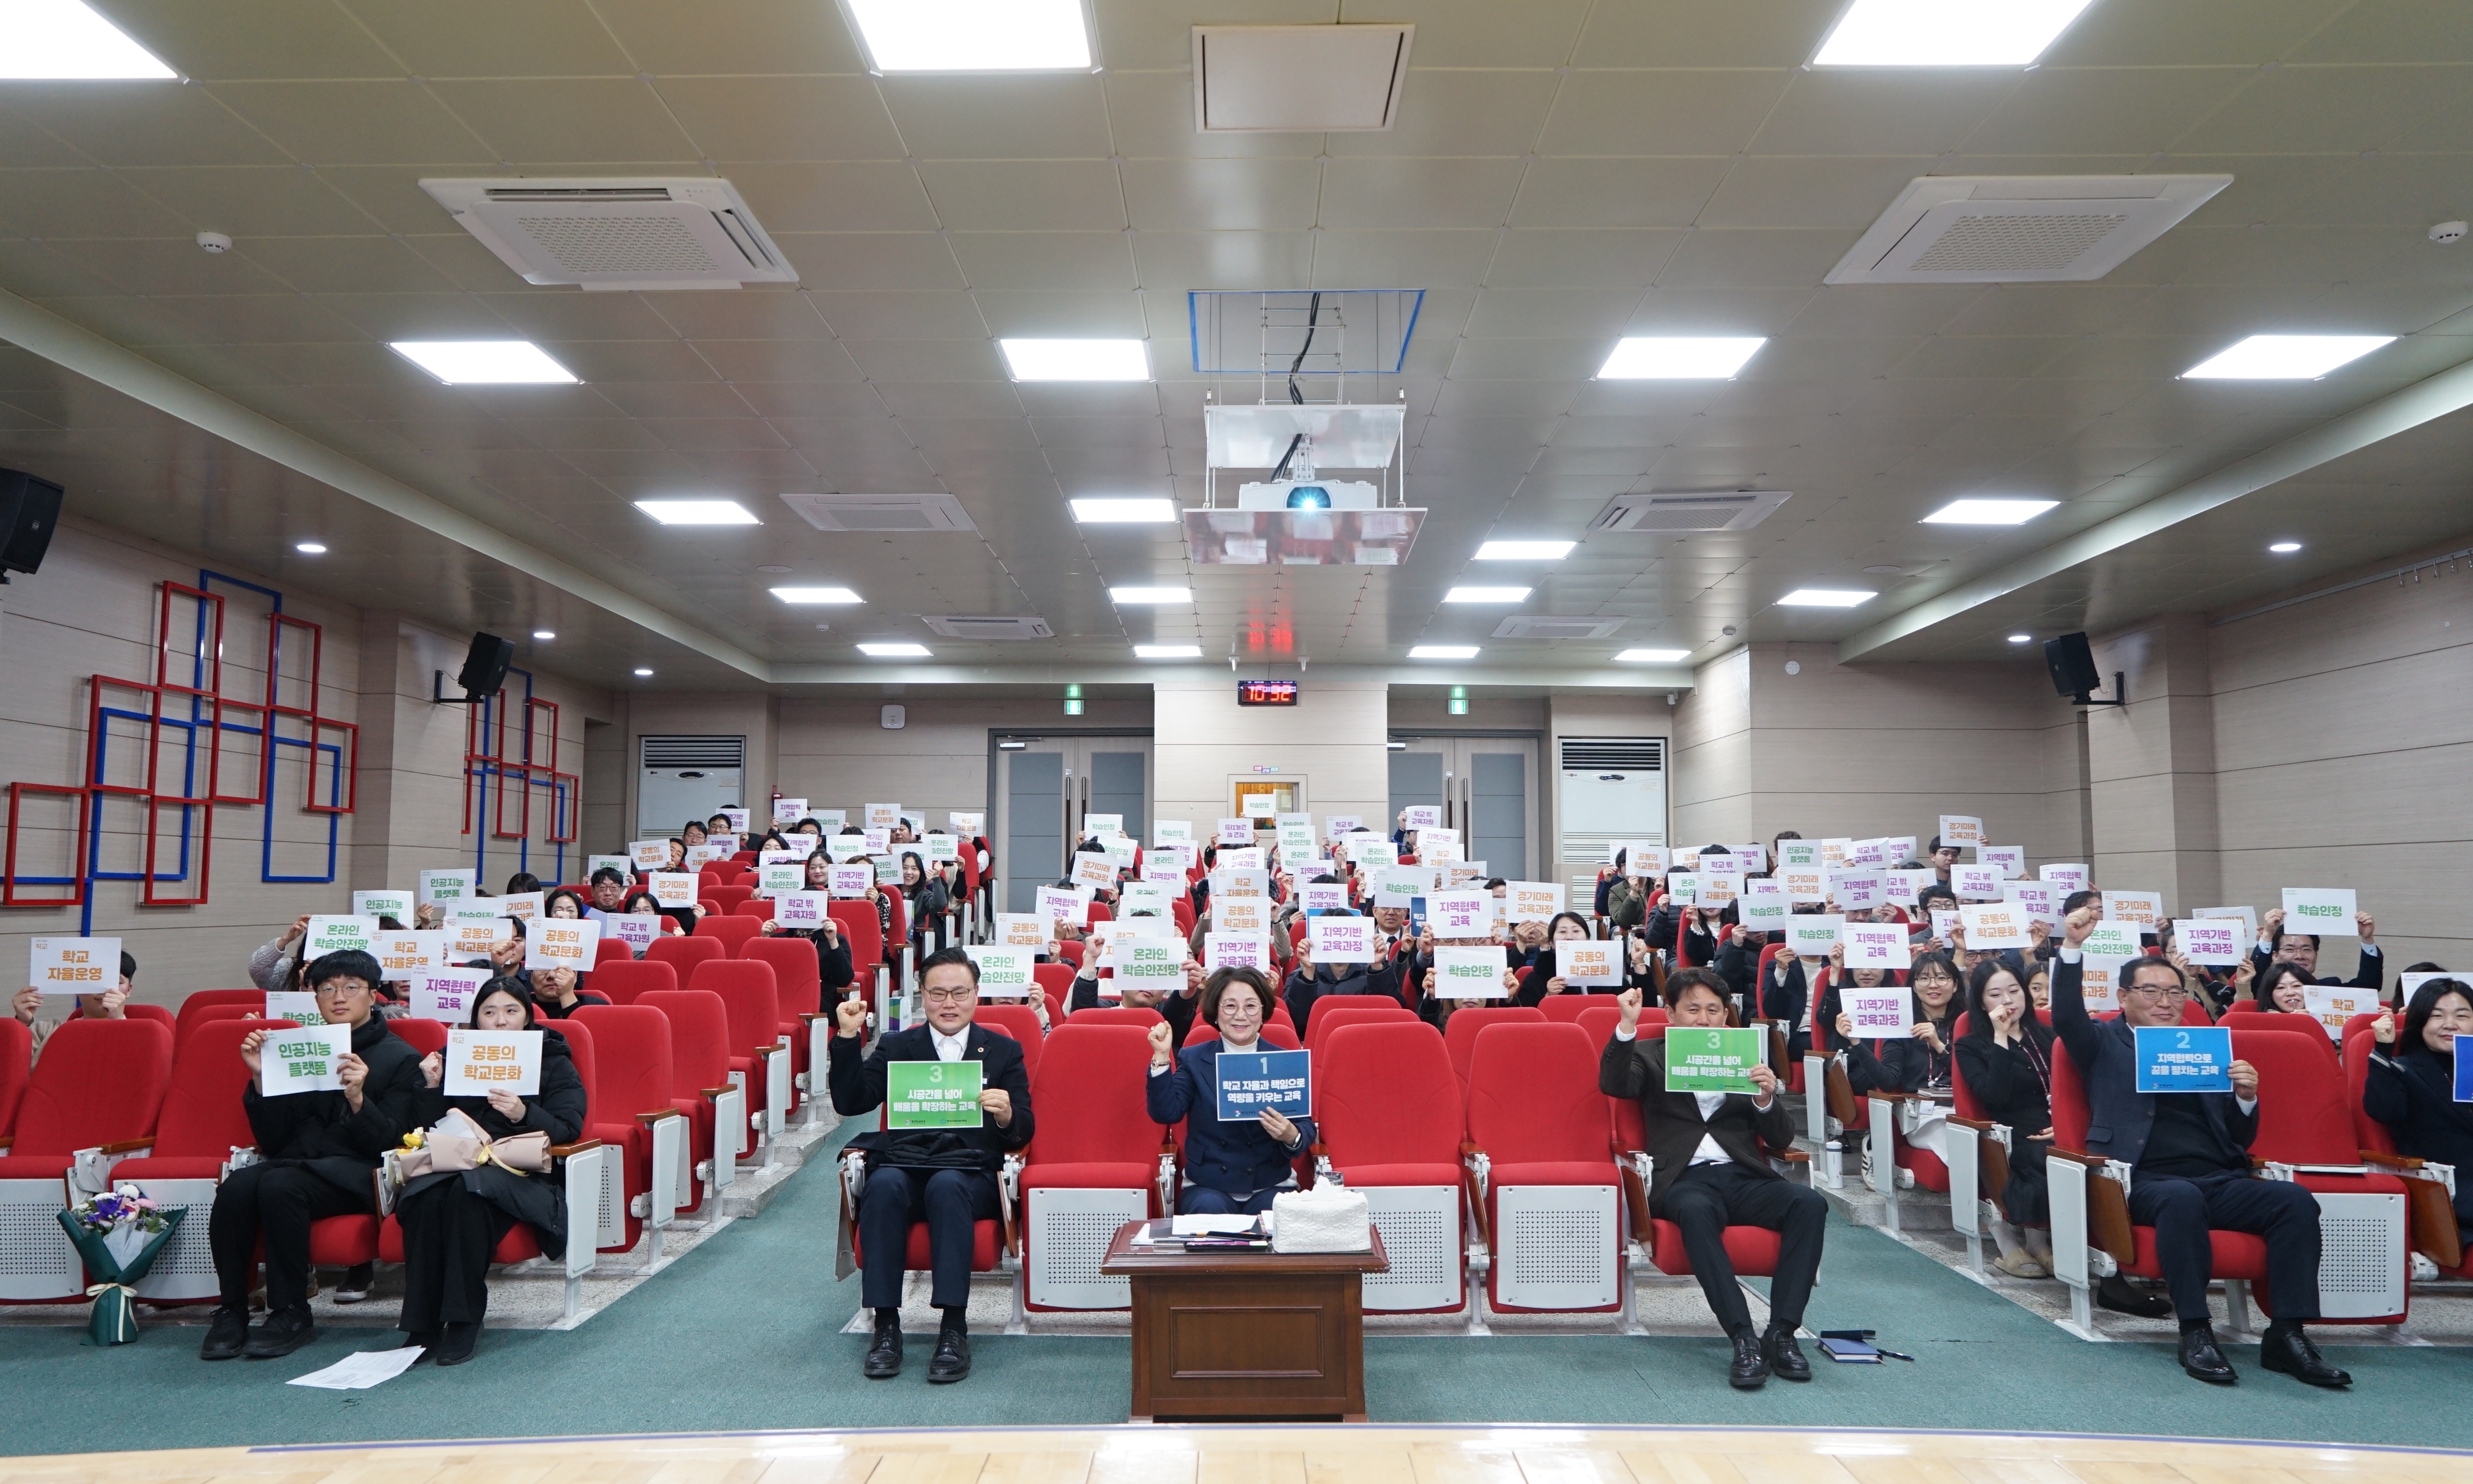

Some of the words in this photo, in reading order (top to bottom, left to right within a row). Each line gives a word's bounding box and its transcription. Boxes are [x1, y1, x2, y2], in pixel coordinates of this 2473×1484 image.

[1426, 833, 1451, 842] 지역기반
[1856, 846, 1870, 854] 학교
[638, 855, 663, 863] 학교문화
[1231, 853, 1256, 861] 지역기반
[1638, 853, 1658, 861] 공동의
[1855, 854, 1882, 864] 교육자원
[1083, 860, 1110, 873] 경기미래
[1300, 867, 1327, 875] 지역협력
[1634, 862, 1661, 870] 학교문화
[837, 871, 864, 880] 지역기반
[1080, 870, 1108, 881] 교육과정
[1149, 872, 1177, 880] 지역협력
[1451, 868, 1479, 876] 경기미래
[1965, 872, 1981, 881] 학교
[1983, 873, 1991, 881] 밖
[2050, 871, 2081, 880] 지역협력
[431, 878, 464, 887] 인공지능
[658, 880, 689, 889] 경기미래
[1235, 878, 1251, 887] 학교
[1844, 880, 1877, 890] 지역협력
[1962, 883, 1993, 891] 교육자원
[434, 889, 460, 899] 플랫폼
[1386, 883, 1419, 894] 학습인정
[1788, 886, 1819, 894] 교육과정
[658, 891, 688, 899] 교육과정
[1308, 892, 1338, 900] 지역기반
[1517, 891, 1553, 902] 경기미래
[1853, 892, 1870, 901] 교육
[2019, 890, 2037, 901] 학교
[2039, 891, 2047, 901] 밖
[366, 900, 403, 909] 인공지능
[788, 899, 803, 908] 학교
[1046, 896, 1079, 908] 지역협력
[1440, 901, 1480, 912] 지역협력
[2114, 901, 2152, 911] 경기미래
[784, 910, 816, 919] 교육자원
[1053, 909, 1069, 917] 교육
[1228, 906, 1254, 916] 공동의
[1517, 903, 1553, 915] 교육과정
[1749, 906, 1783, 916] 학습인정
[2297, 904, 2342, 917] 학습인정
[1223, 918, 1259, 928] 학교문화
[1450, 915, 1470, 926] 교육
[1979, 913, 2011, 924] 공동의
[327, 925, 359, 935] 온라인
[620, 922, 637, 931] 학교
[639, 923, 647, 932] 밖
[1012, 923, 1039, 932] 공동의
[1323, 927, 1363, 938] 지역기반
[1977, 927, 2018, 938] 학교문화
[461, 928, 493, 939] 공동의
[546, 930, 579, 943] 공동의
[617, 933, 650, 943] 교육자원
[1798, 929, 1834, 939] 학습인정
[1856, 933, 1896, 944] 지역협력
[2090, 930, 2121, 941] 온라인
[2189, 929, 2231, 940] 지역기반
[314, 938, 368, 950] 학습안전망
[1007, 935, 1043, 945] 학교문화
[394, 942, 417, 953] 학교
[540, 945, 583, 959] 학교문화
[1217, 942, 1257, 952] 지역기반
[1323, 941, 1363, 952] 교육과정
[1867, 947, 1887, 957] 교육
[2081, 943, 2133, 955] 학습안전망
[2191, 943, 2233, 954] 교육과정
[62, 950, 89, 963] 학교
[1134, 948, 1167, 960] 온라인
[1574, 952, 1605, 962] 공동의
[982, 956, 1015, 967] 온라인
[1217, 956, 1257, 966] 교육과정
[48, 967, 102, 980] 자율운영
[1122, 964, 1179, 976] 학습안전망
[1449, 964, 1493, 977] 학습인정
[1569, 966, 1610, 976] 학교문화
[426, 979, 476, 994] 지역협력
[437, 997, 461, 1010] 교육
[1856, 999, 1898, 1011] 지역기반
[2332, 998, 2355, 1011] 학교
[1858, 1014, 1899, 1026] 교육과정
[1707, 1032, 1720, 1049] 3
[2176, 1032, 2191, 1049] 2
[279, 1042, 331, 1058] 인공지능
[472, 1045, 515, 1060] 공동의
[1686, 1055, 1721, 1066] 시공간을
[1723, 1055, 1741, 1066] 넘어
[2157, 1053, 2212, 1063] 지역협력으로
[289, 1061, 327, 1077] 플랫폼
[1260, 1057, 1268, 1074] 1
[2151, 1065, 2169, 1075] 꿈을
[2171, 1065, 2198, 1076] 펼치는
[2200, 1065, 2219, 1075] 교육
[464, 1064, 522, 1080] 학교문화
[929, 1065, 942, 1083] 3
[1672, 1066, 1698, 1076] 배움을
[1700, 1066, 1735, 1077] 확장하는
[1222, 1080, 1240, 1090] 학교
[1242, 1080, 1269, 1091] 자율과
[1271, 1078, 1305, 1090] 책임으로
[907, 1089, 942, 1100] 시공간을
[945, 1089, 962, 1100] 넘어
[1227, 1092, 1254, 1103] 역량을
[1256, 1092, 1282, 1102] 키우는
[1284, 1090, 1301, 1101] 교육
[893, 1102, 920, 1112] 배움을
[922, 1101, 957, 1111] 확장하는
[959, 1101, 976, 1111] 교육
